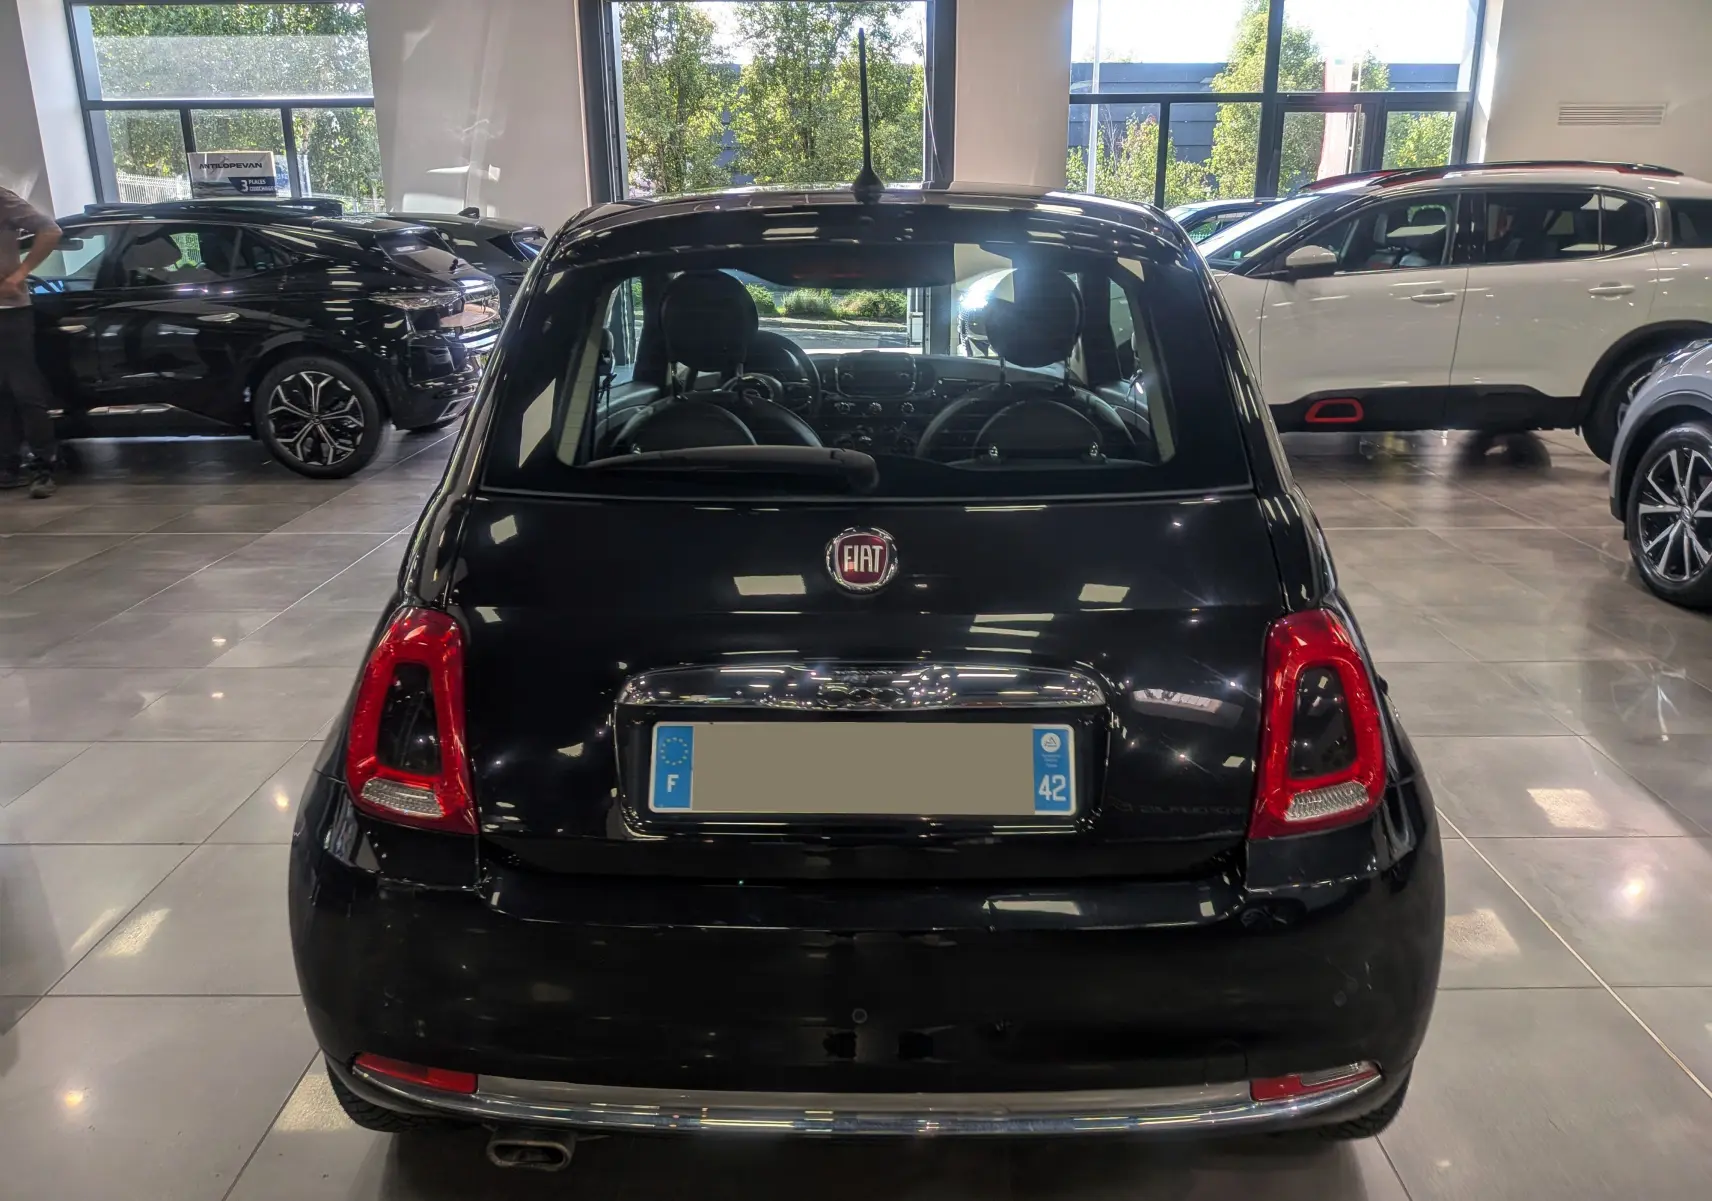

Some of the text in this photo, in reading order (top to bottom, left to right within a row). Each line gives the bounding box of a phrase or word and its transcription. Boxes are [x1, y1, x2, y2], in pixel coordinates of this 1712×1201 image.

[241, 179, 249, 192] 3
[843, 544, 884, 573] FIAT
[667, 774, 680, 793] F
[1039, 774, 1067, 802] 42
